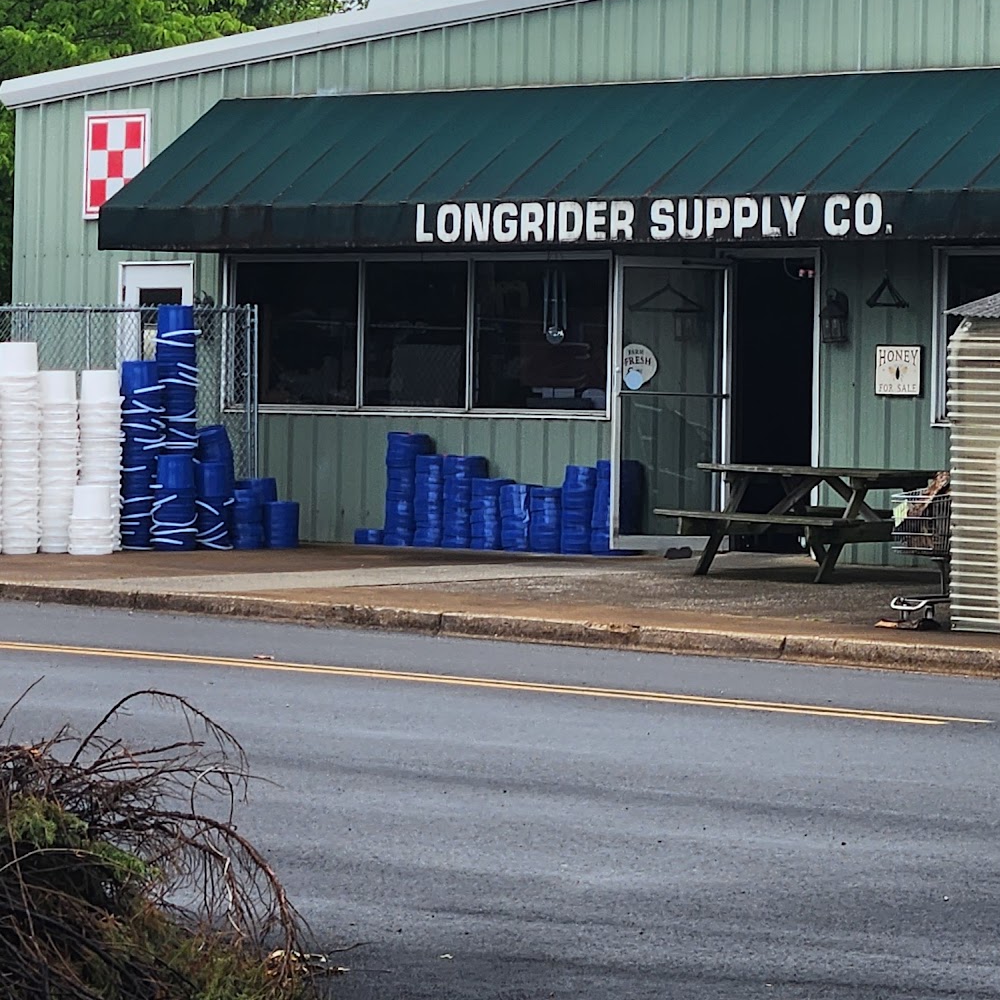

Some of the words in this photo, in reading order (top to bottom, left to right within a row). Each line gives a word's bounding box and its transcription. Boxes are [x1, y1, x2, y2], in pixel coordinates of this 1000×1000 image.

[415, 200, 635, 243] LONGRIDER
[649, 195, 807, 241] SUPPLY
[824, 193, 893, 237] CO.
[624, 356, 651, 367] FRESH
[879, 349, 919, 366] HONEY
[879, 383, 893, 393] FOR
[897, 383, 917, 393] SALE
